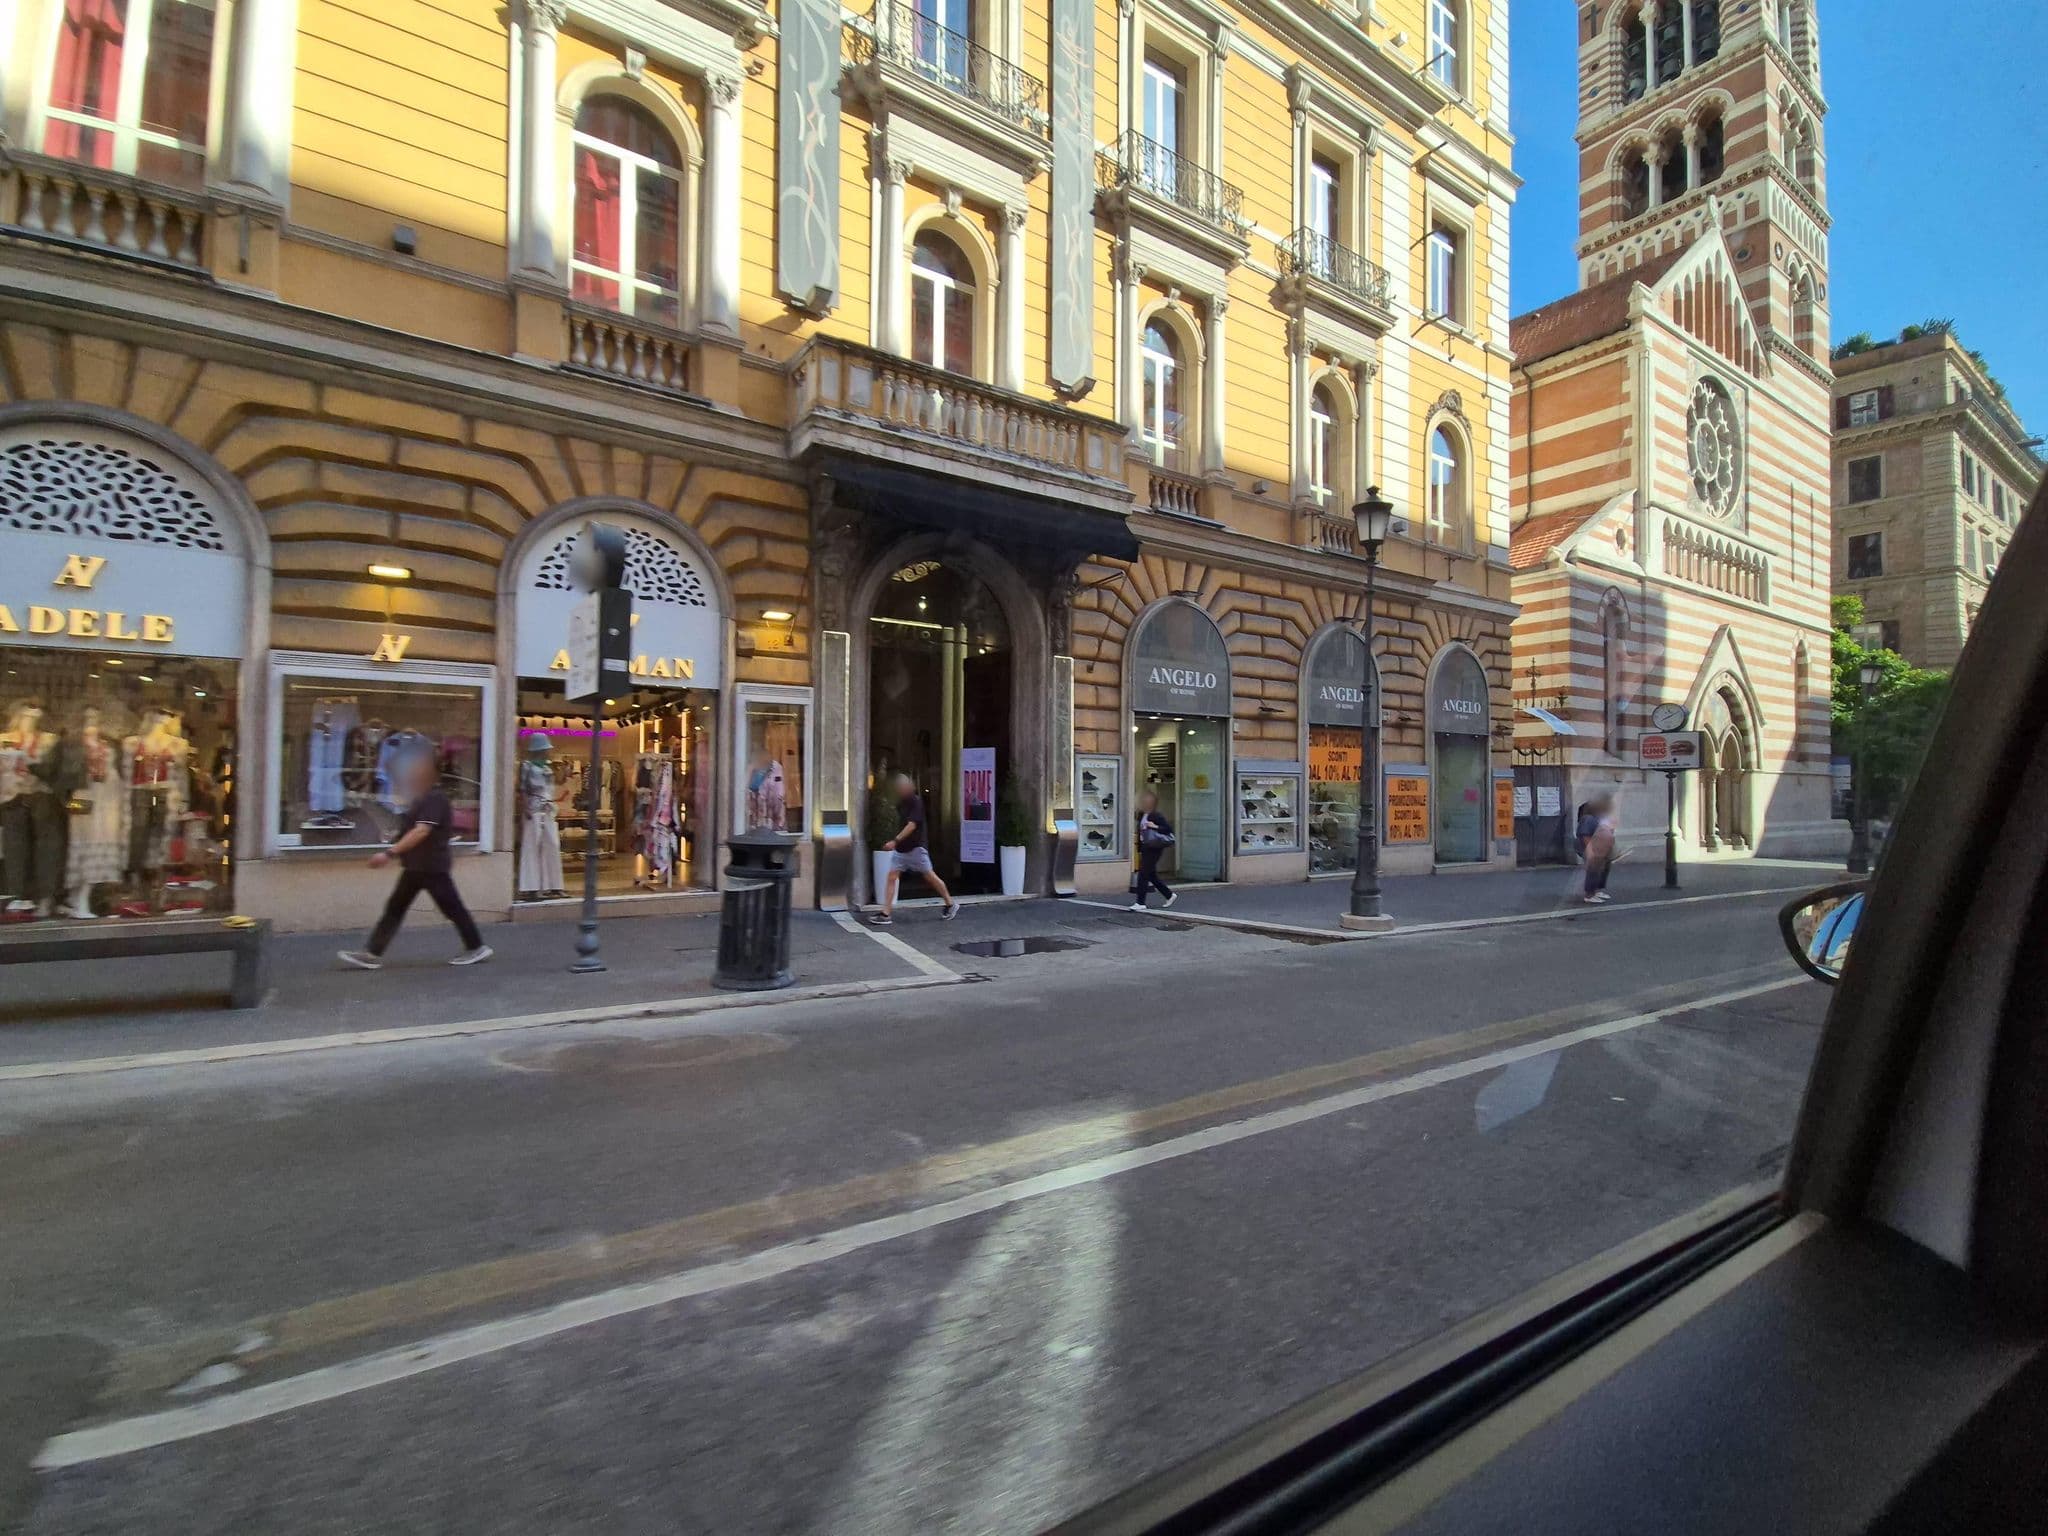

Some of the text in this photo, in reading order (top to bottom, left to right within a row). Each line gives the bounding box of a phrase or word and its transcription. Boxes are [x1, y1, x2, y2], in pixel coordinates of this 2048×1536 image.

[549, 649, 694, 679] AMAN
[1149, 667, 1217, 689] ANGELO
[1442, 699, 1481, 714] ANGELO
[1328, 751, 1348, 762] SCONTI
[1325, 765, 1340, 782] 10%
[1341, 765, 1351, 781] AL
[1398, 779, 1417, 791] VENDITA
[1389, 795, 1426, 807] PROMOZIONALE
[1394, 809, 1411, 820] SCONTI
[1404, 824, 1412, 838] AL
